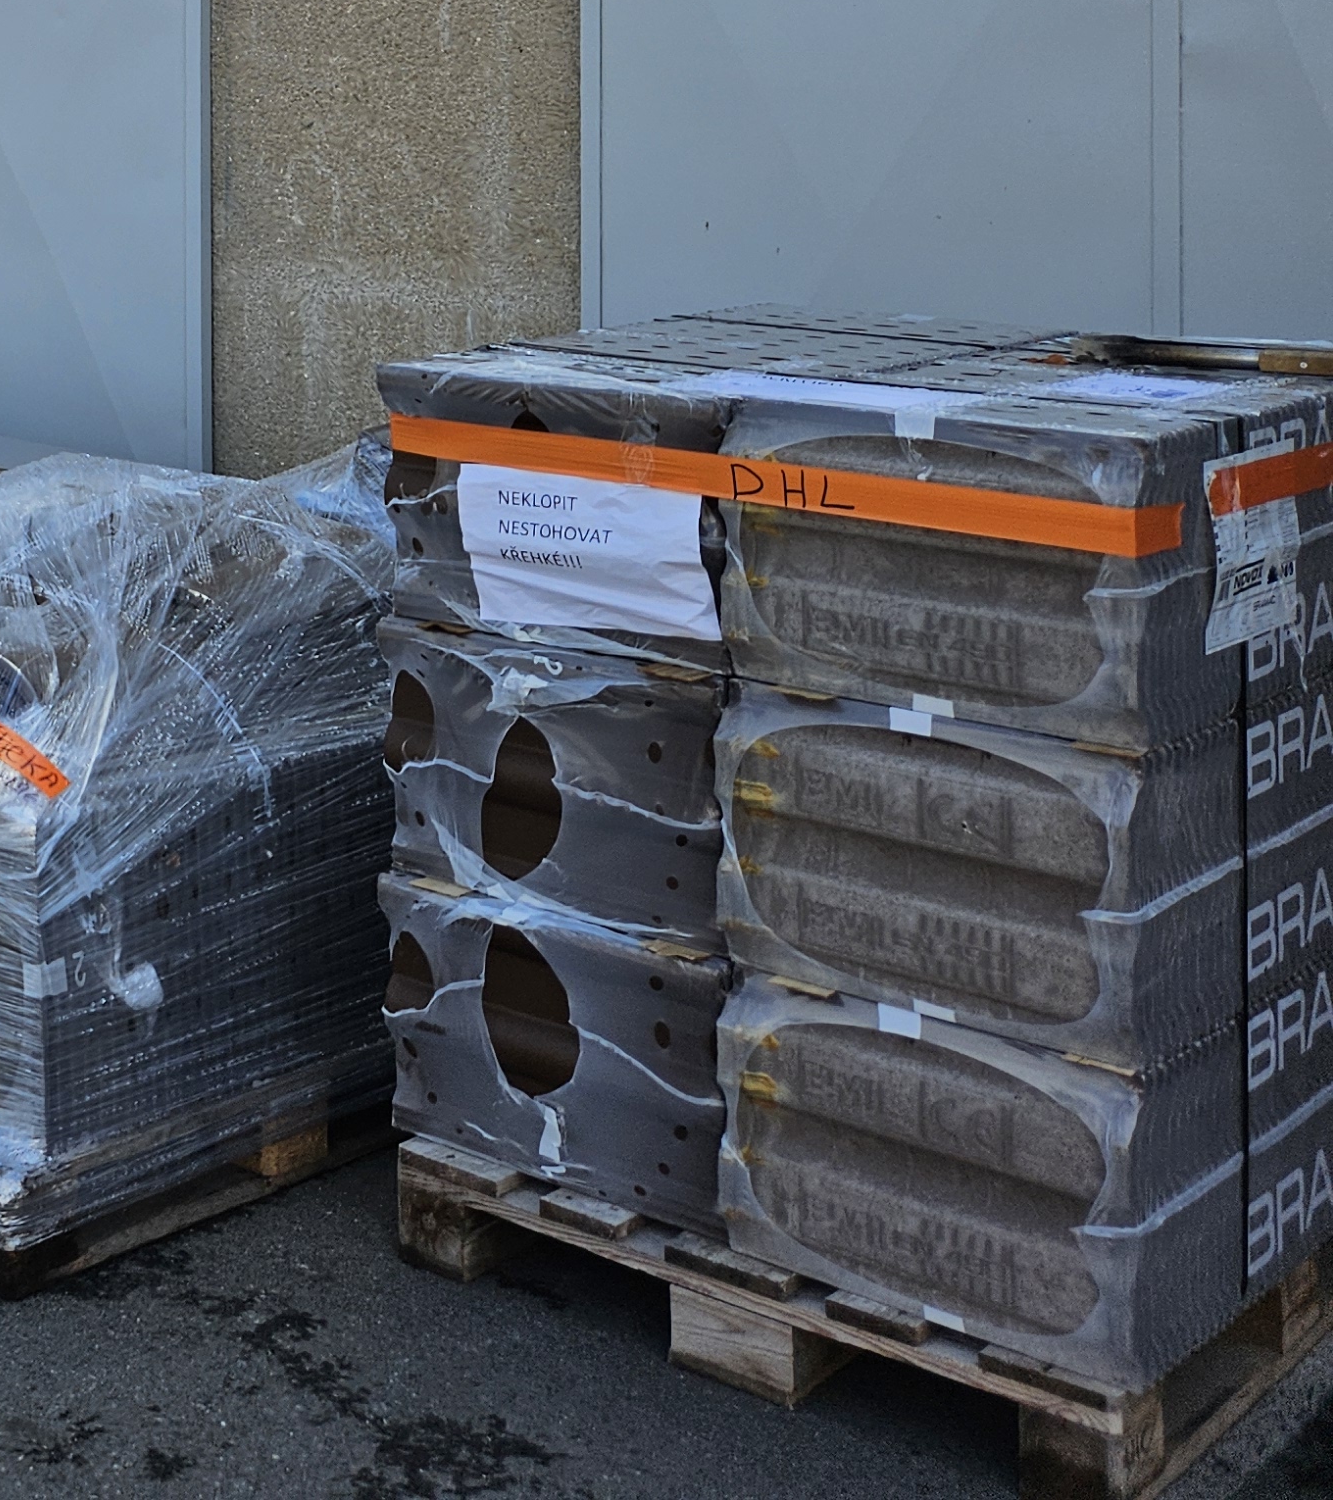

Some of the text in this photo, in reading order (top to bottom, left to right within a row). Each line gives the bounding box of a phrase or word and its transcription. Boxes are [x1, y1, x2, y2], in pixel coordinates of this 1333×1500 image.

[730, 463, 855, 511] DHL
[498, 490, 578, 512] NEKLOPIT
[499, 519, 613, 544] NESTOHOVAT
[500, 546, 583, 569] KŘEHKÉ!!!
